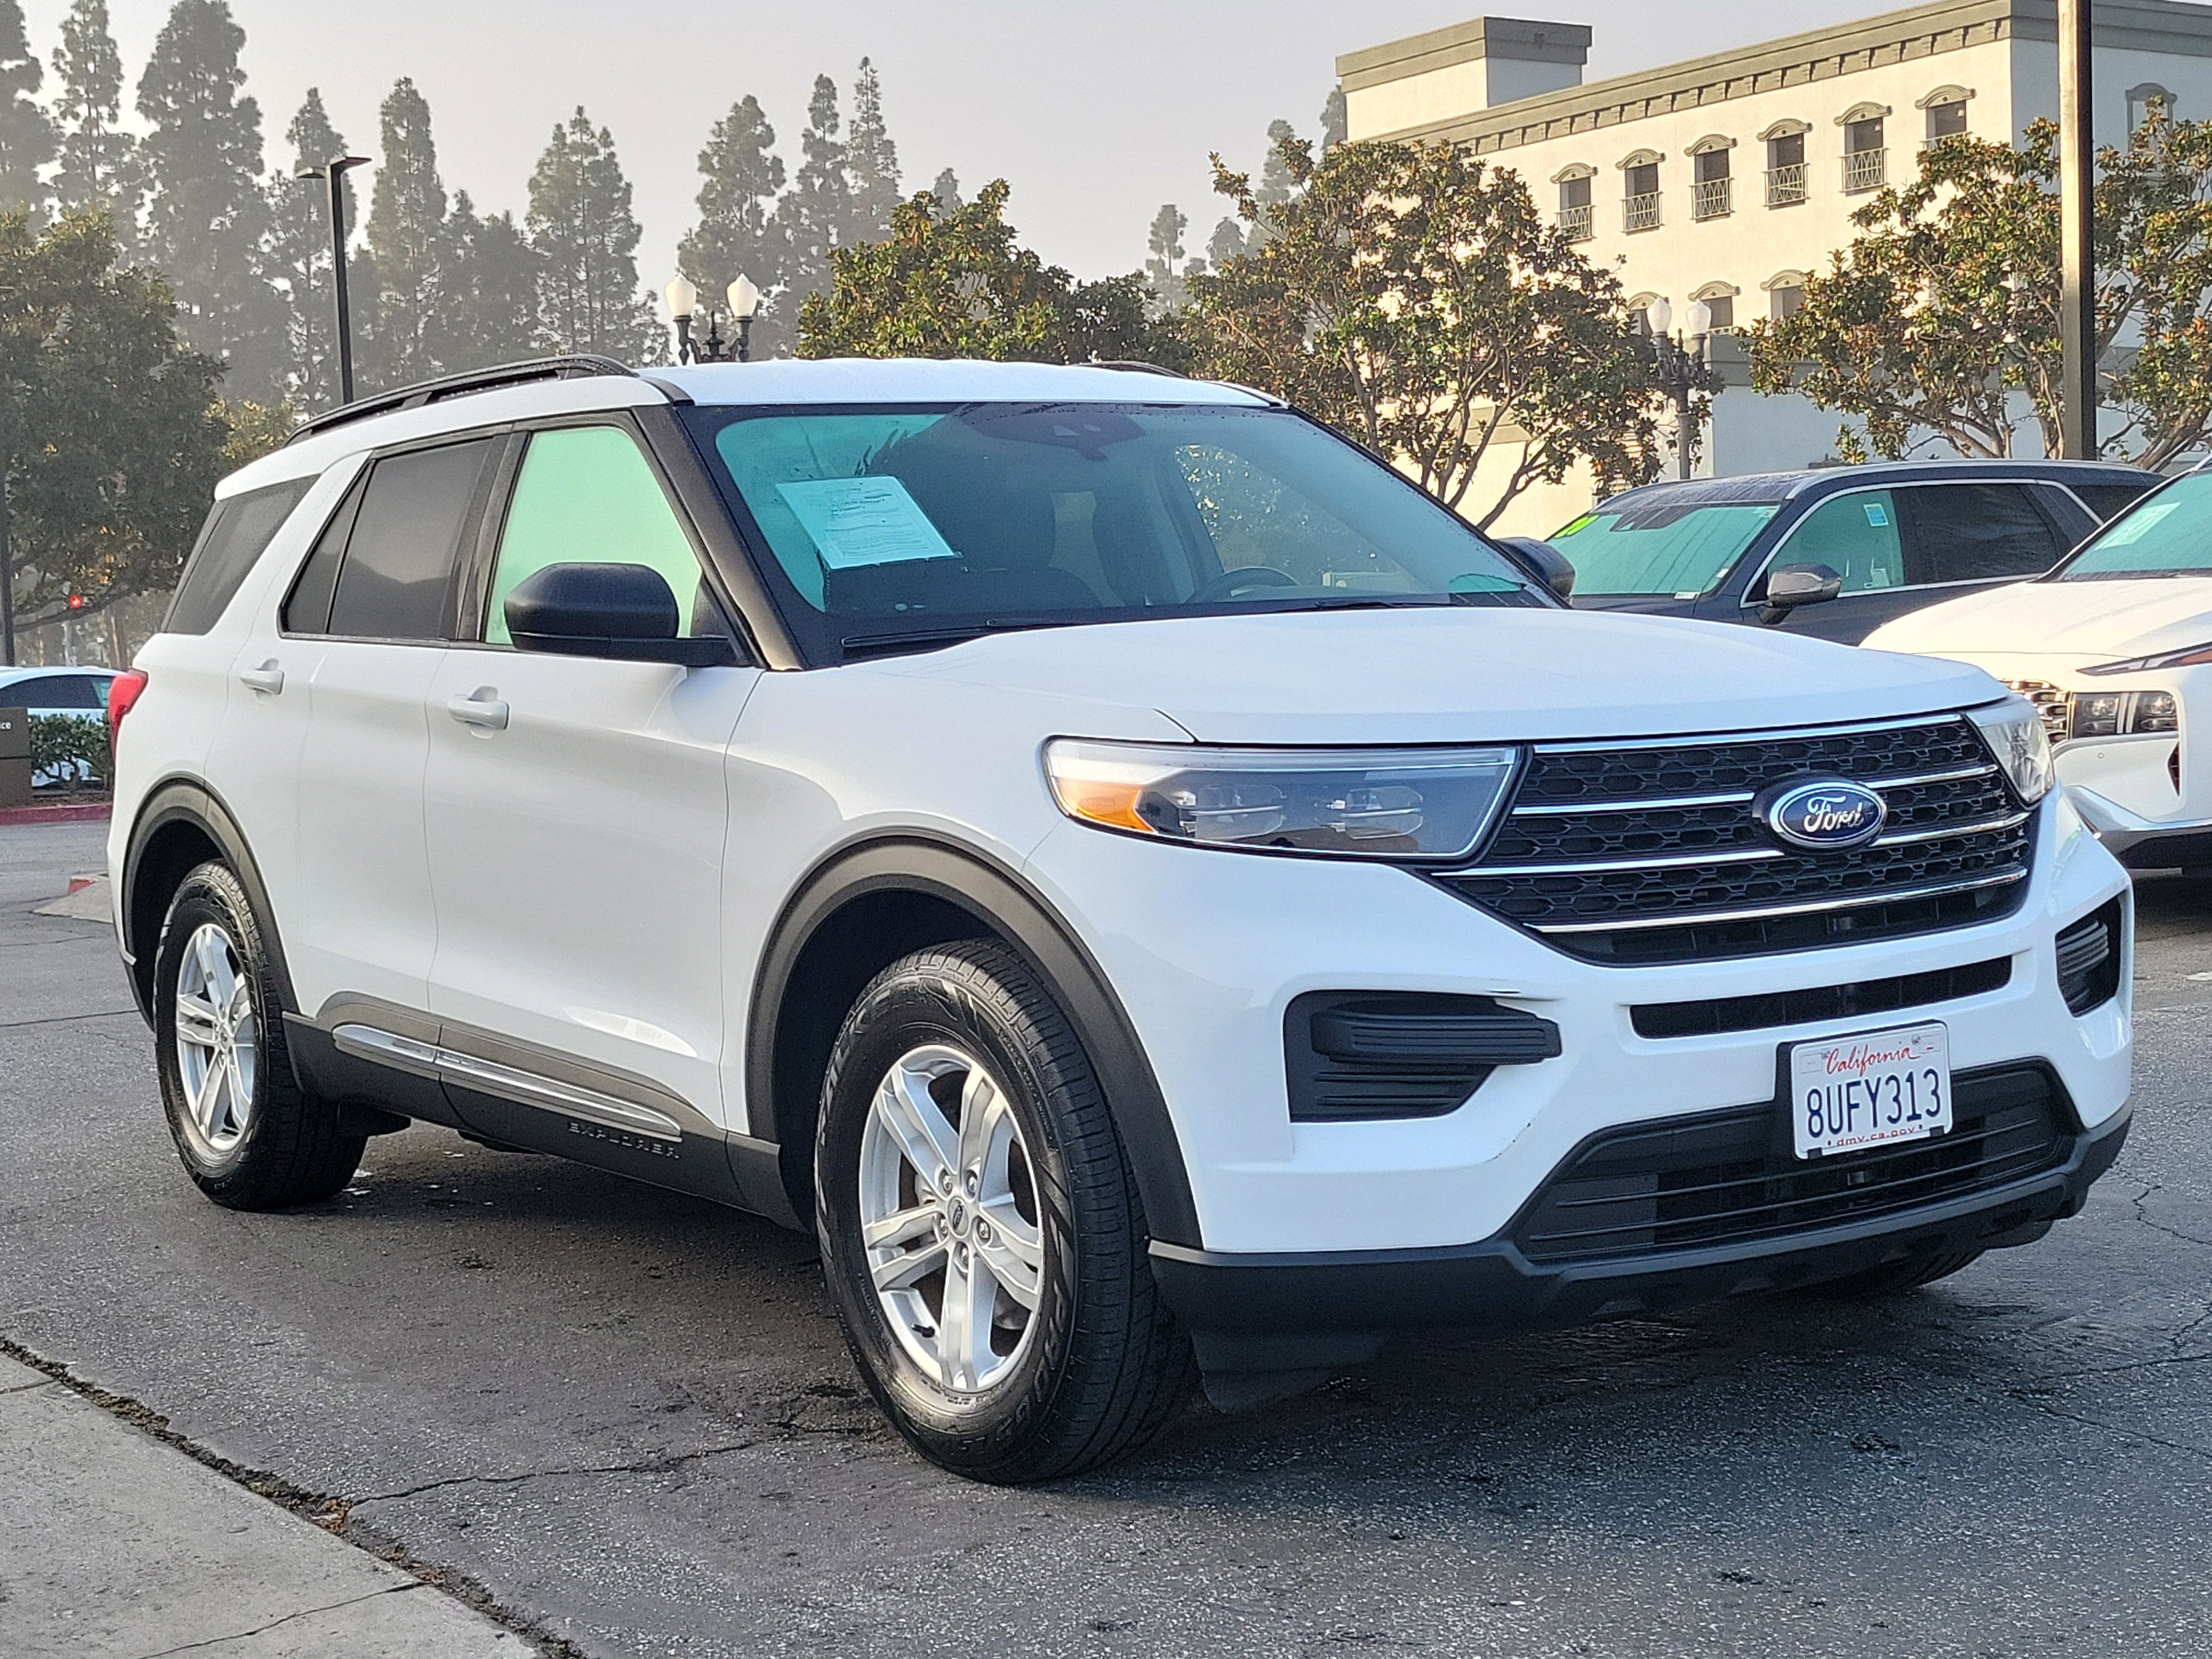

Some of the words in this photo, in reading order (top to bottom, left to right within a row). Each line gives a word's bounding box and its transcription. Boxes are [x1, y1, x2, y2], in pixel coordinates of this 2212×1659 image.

[1804, 795, 1864, 832] Ford
[1826, 1043, 1921, 1077] California
[1807, 1068, 1942, 1138] 8UFY313
[568, 1122, 680, 1159] EXPLORER
[1836, 1126, 1916, 1147] dmv.ca.gov
